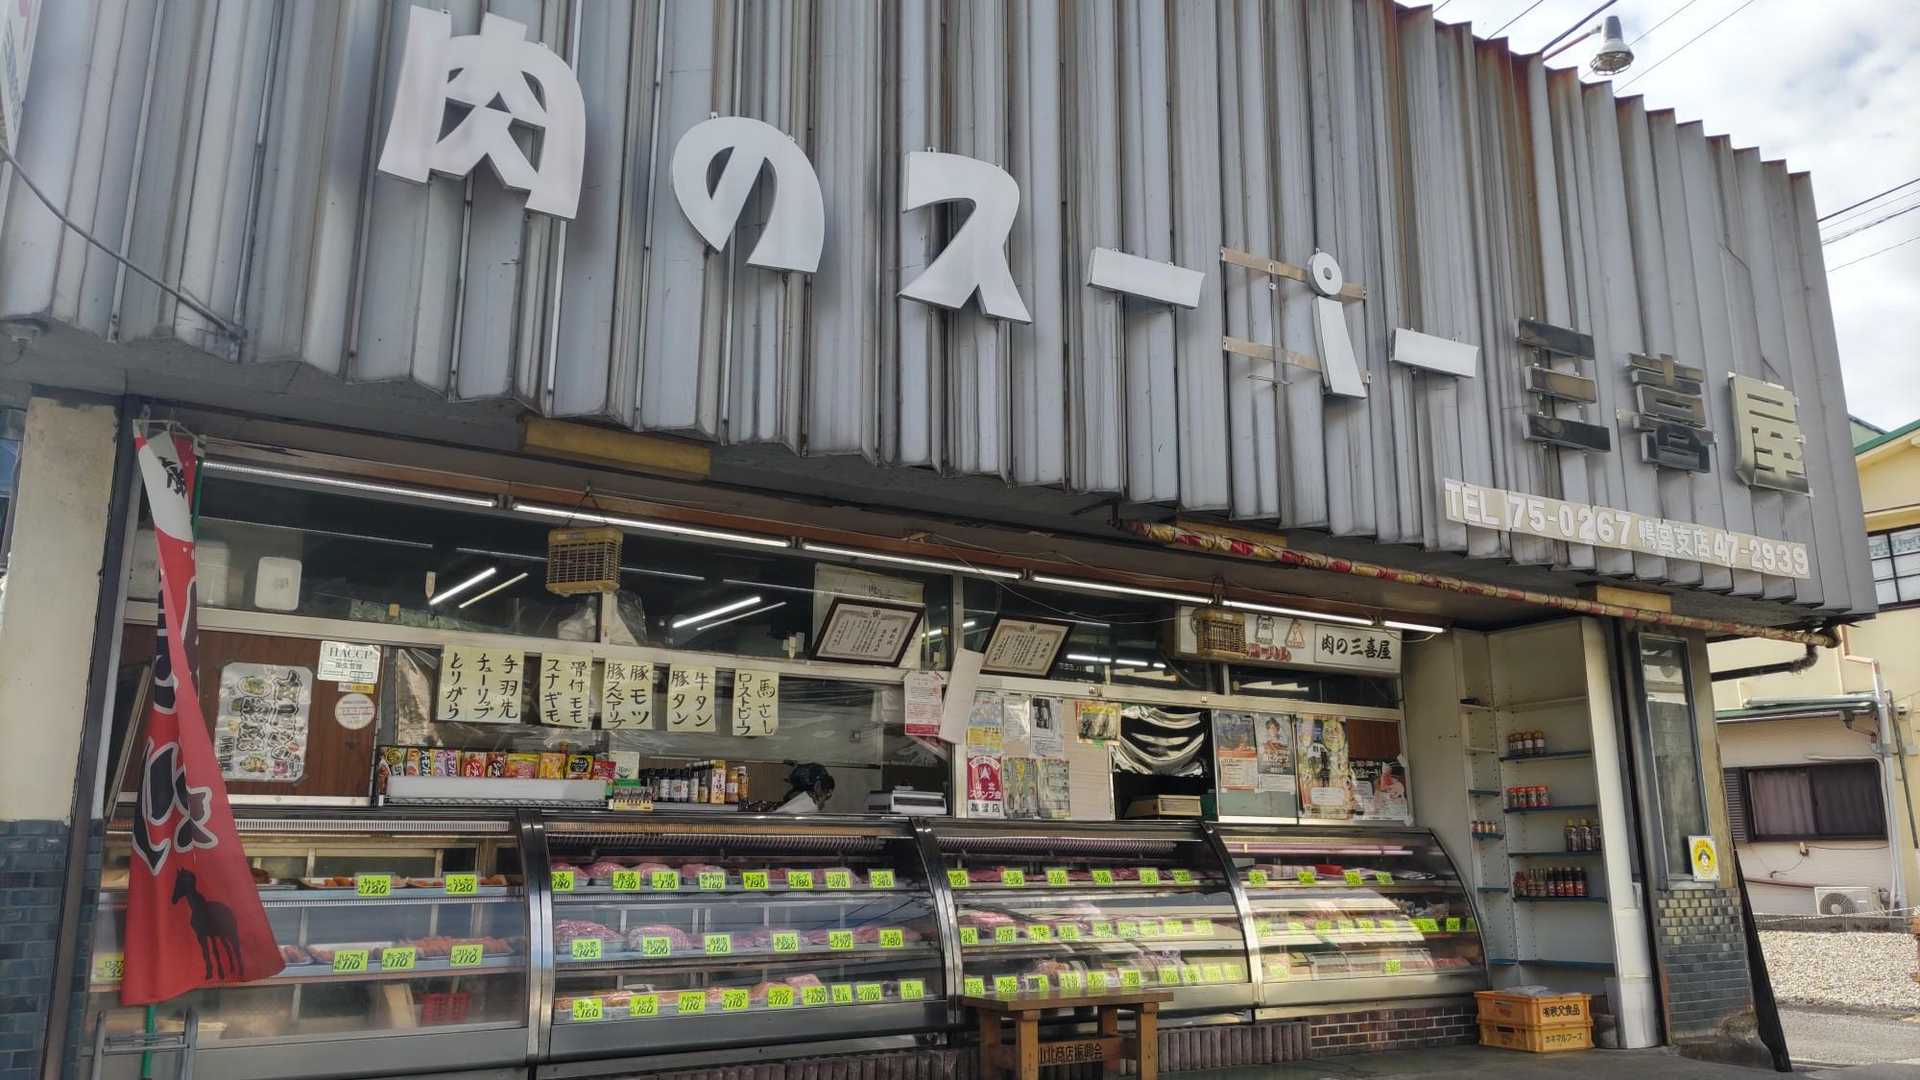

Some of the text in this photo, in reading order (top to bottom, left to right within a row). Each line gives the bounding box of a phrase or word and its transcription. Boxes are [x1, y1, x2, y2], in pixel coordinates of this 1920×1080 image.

[1445, 479, 1499, 526] TEL
[1508, 493, 1632, 545] 75-0267
[1713, 530, 1810, 577] 47-2939
[1321, 633, 1392, 659] 肉の三喜屋
[446, 652, 467, 720] とりがら
[473, 653, 495, 719] チューリップ
[498, 654, 519, 720] 手羽先
[544, 658, 563, 723] スナギモ
[569, 661, 587, 724] 骨付モモ
[605, 662, 626, 730] 豚スペアリブ
[630, 664, 650, 725] 豚モツ
[671, 670, 690, 726] 豚タン
[694, 672, 713, 728] 牛タン
[736, 673, 752, 735] ローストビーフ
[756, 678, 776, 735] 馬さし
